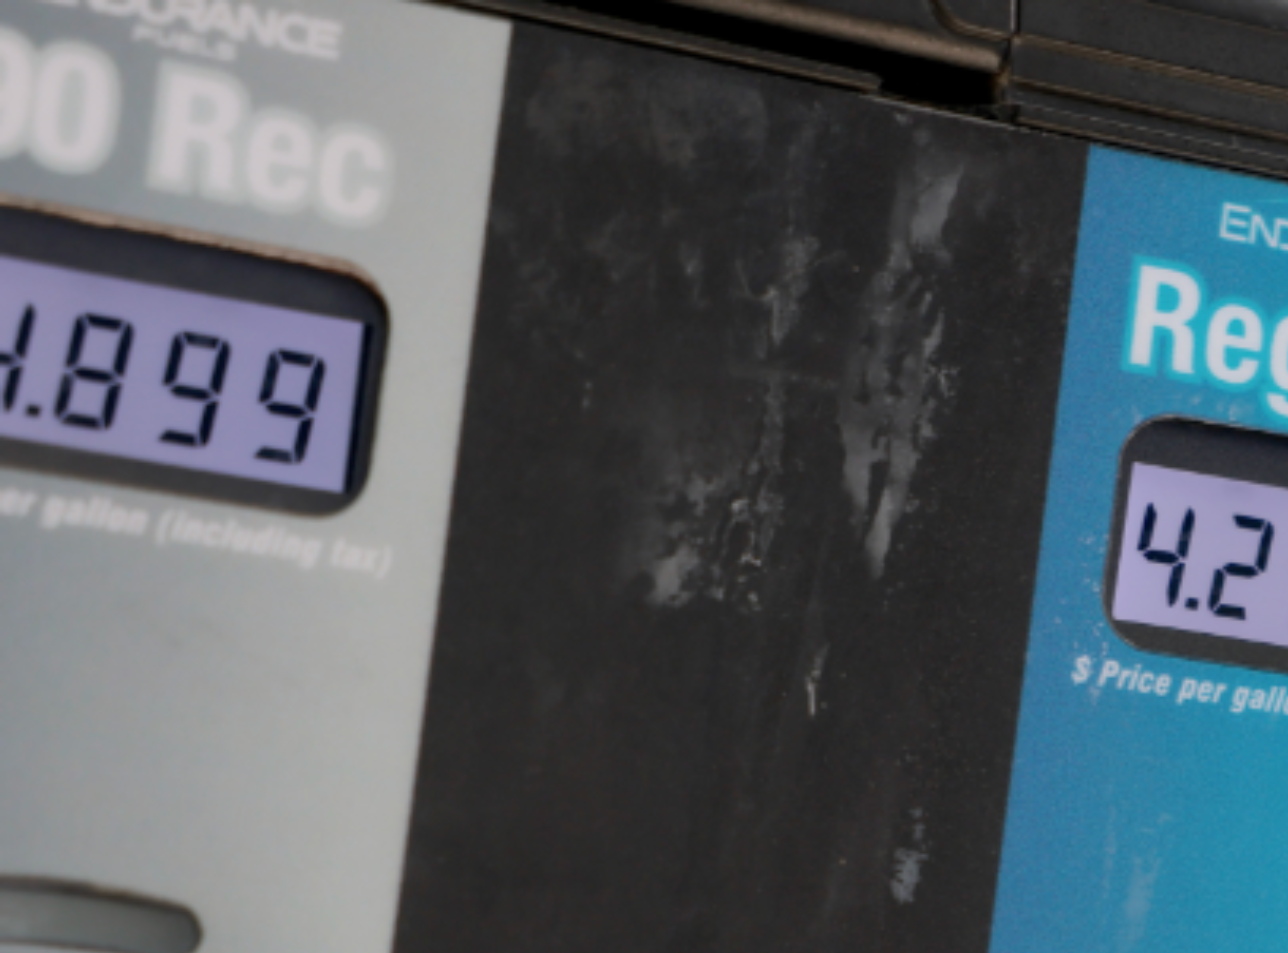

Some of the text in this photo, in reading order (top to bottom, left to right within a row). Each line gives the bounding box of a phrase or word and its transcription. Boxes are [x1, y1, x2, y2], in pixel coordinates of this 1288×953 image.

[145, 58, 391, 228] Rec
[38, 491, 149, 537] gallon
[155, 510, 322, 568] (including
[1071, 655, 1093, 685] $
[1099, 658, 1171, 695] Price
[1177, 674, 1225, 705] per
